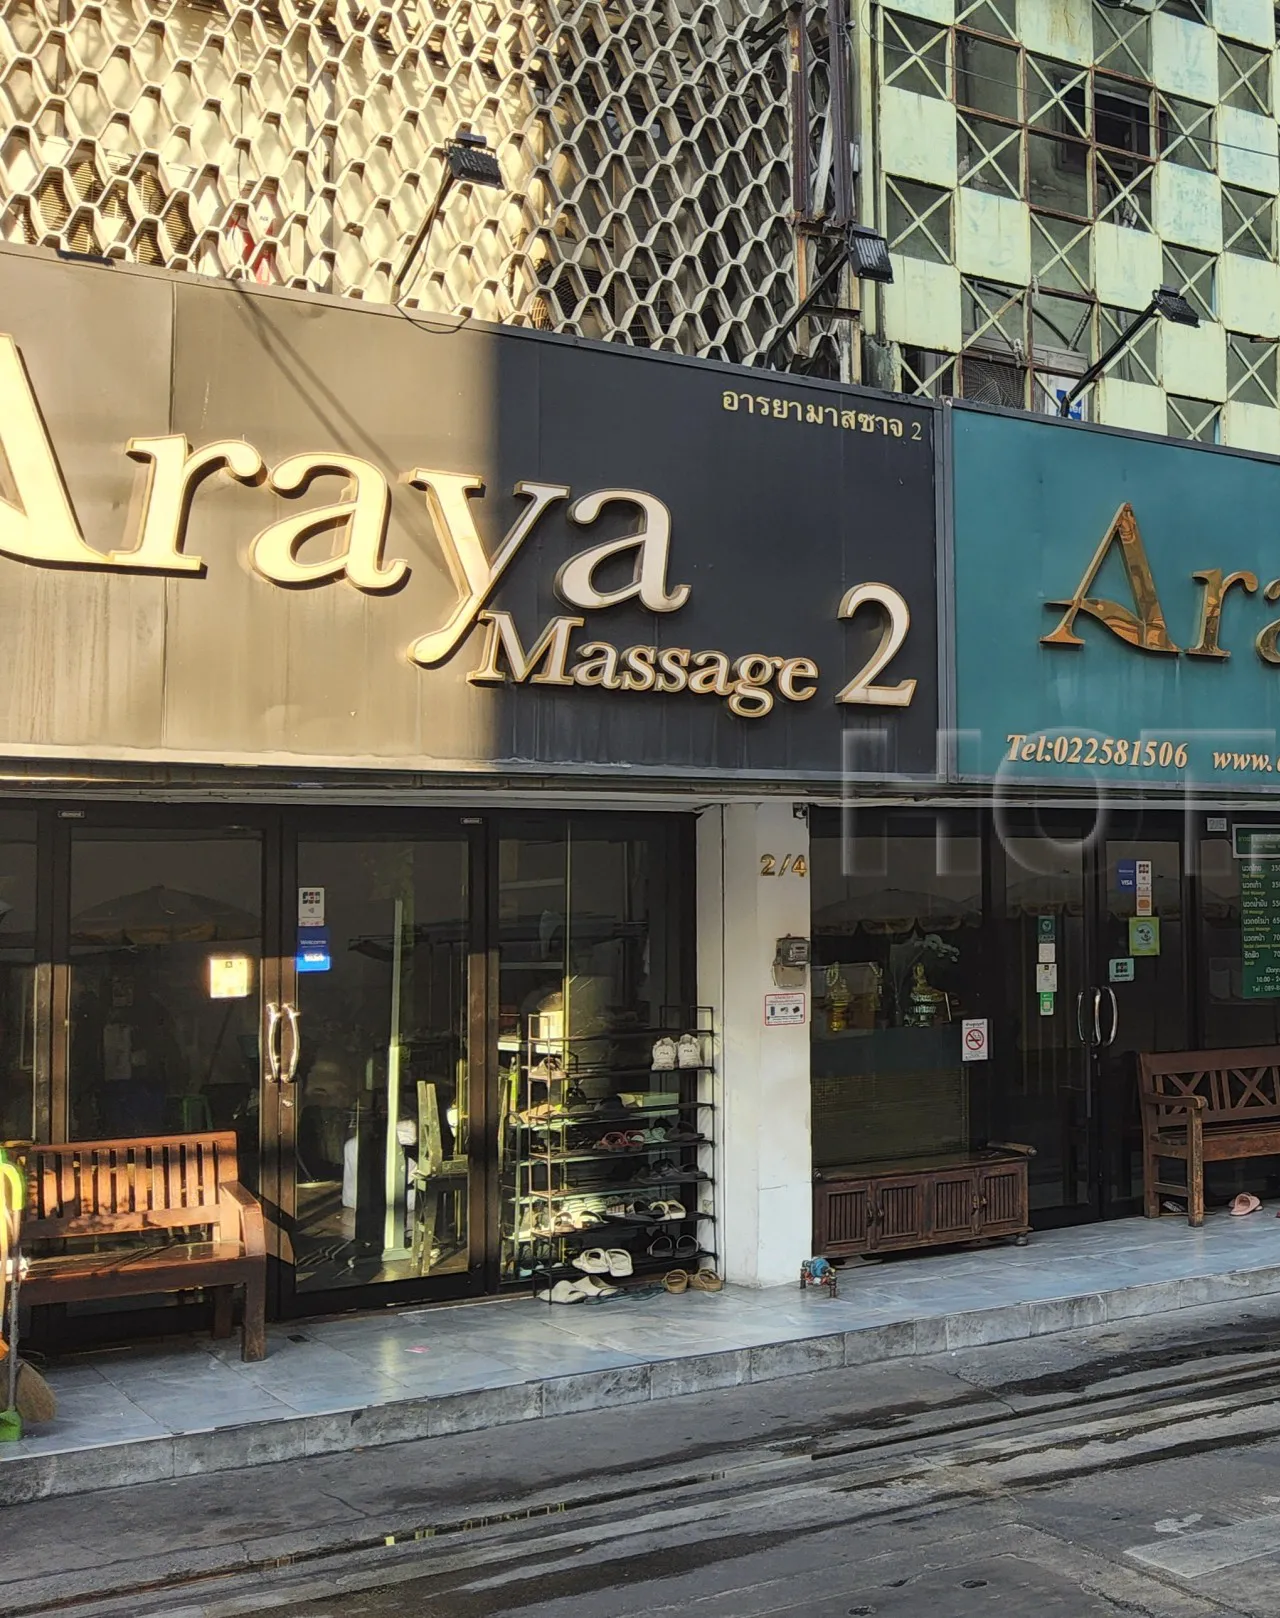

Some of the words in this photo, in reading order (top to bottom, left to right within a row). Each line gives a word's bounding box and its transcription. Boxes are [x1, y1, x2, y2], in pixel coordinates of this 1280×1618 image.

[722, 390, 903, 438] อารยามาสซาจ
[911, 422, 923, 441] 2
[466, 608, 819, 720] Massage
[836, 582, 916, 708] 2
[1006, 733, 1189, 769] Tel:022581506
[760, 853, 807, 877] 2/4
